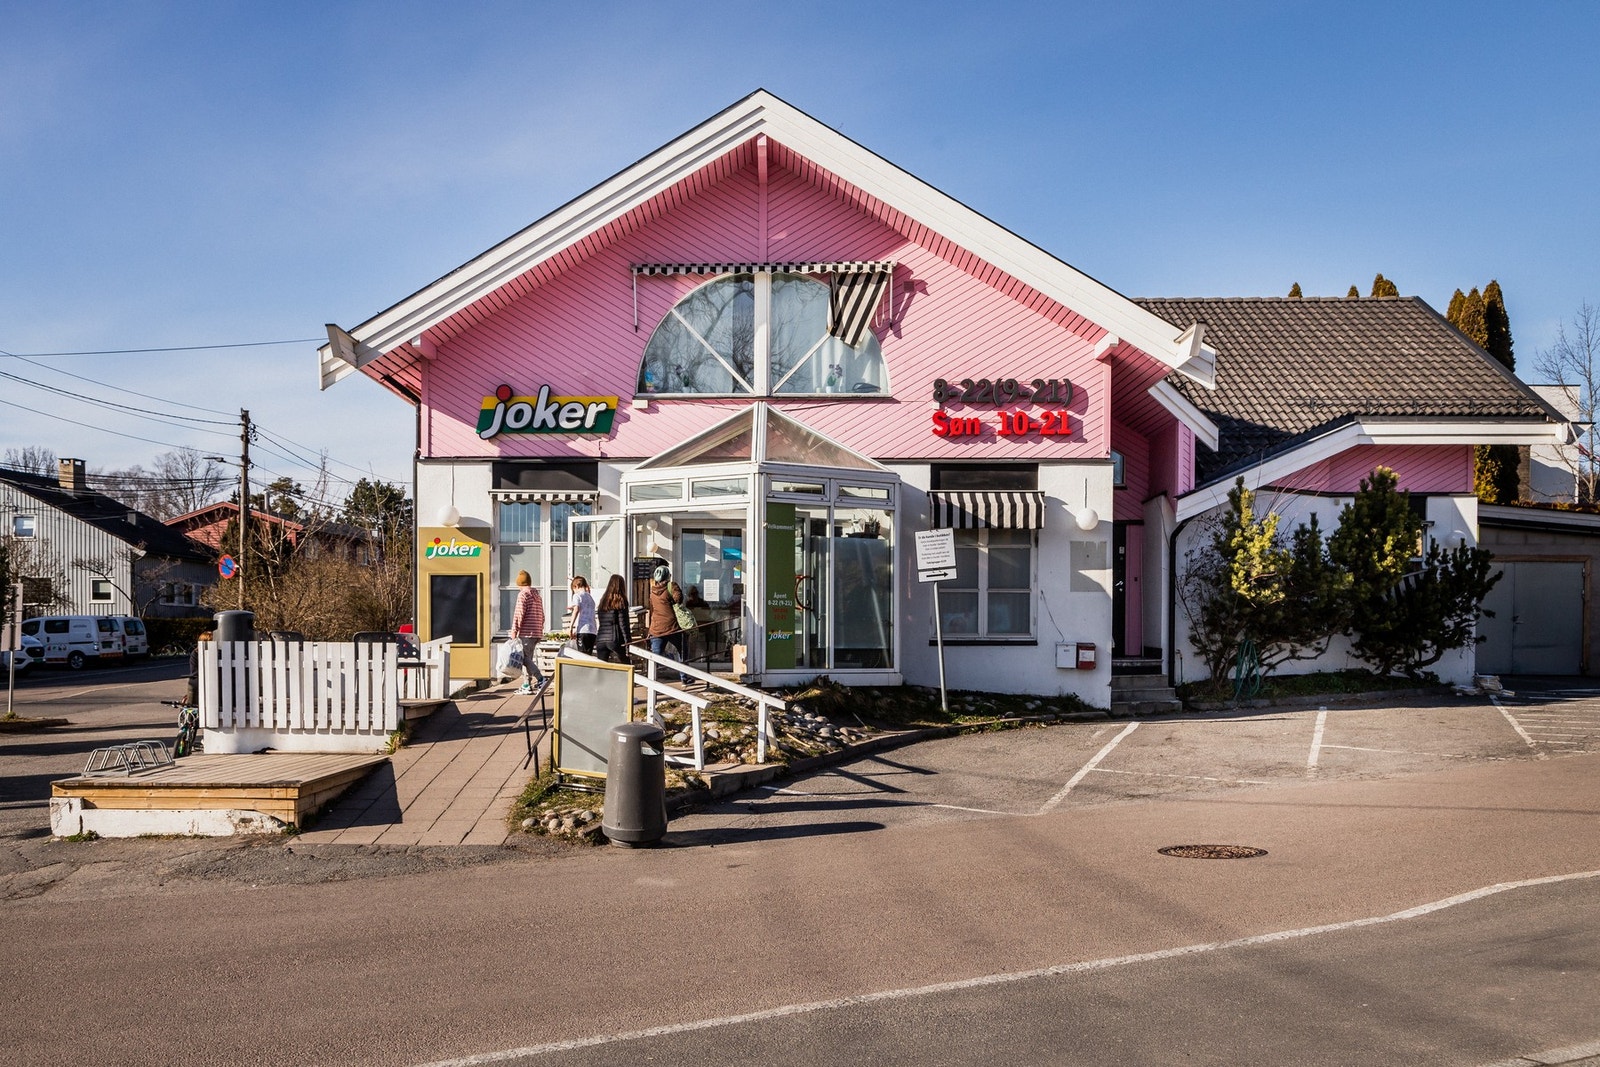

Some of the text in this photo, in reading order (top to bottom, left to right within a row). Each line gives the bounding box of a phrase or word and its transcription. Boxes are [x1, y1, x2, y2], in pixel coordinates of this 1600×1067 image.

[933, 378, 1073, 407] 8-22(9-21)
[480, 384, 608, 439] joker
[932, 410, 1072, 436] Søn 10-21
[427, 537, 478, 560] joker
[768, 630, 792, 641] joker
